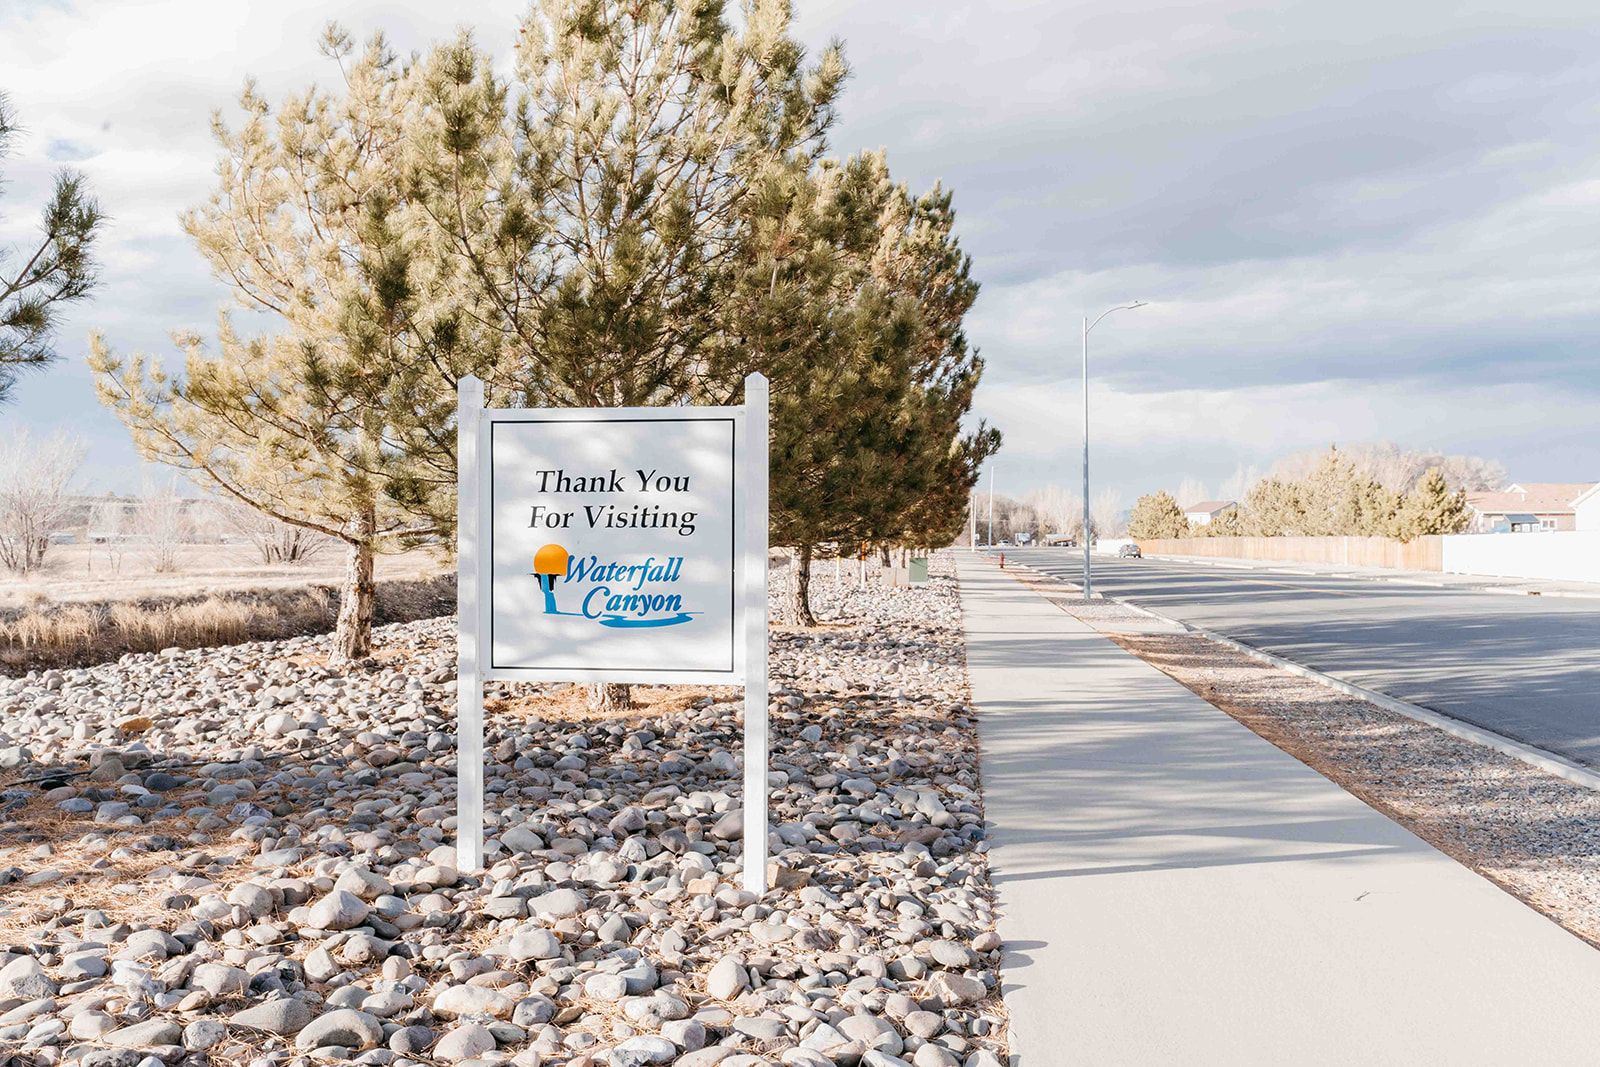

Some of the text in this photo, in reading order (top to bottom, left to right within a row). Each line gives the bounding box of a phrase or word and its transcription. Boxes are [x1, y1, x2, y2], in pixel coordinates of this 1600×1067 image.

[535, 469, 690, 493] Thank You
[527, 504, 698, 537] For Visiting
[564, 555, 684, 591] Waterfall
[582, 586, 682, 620] Canyon
